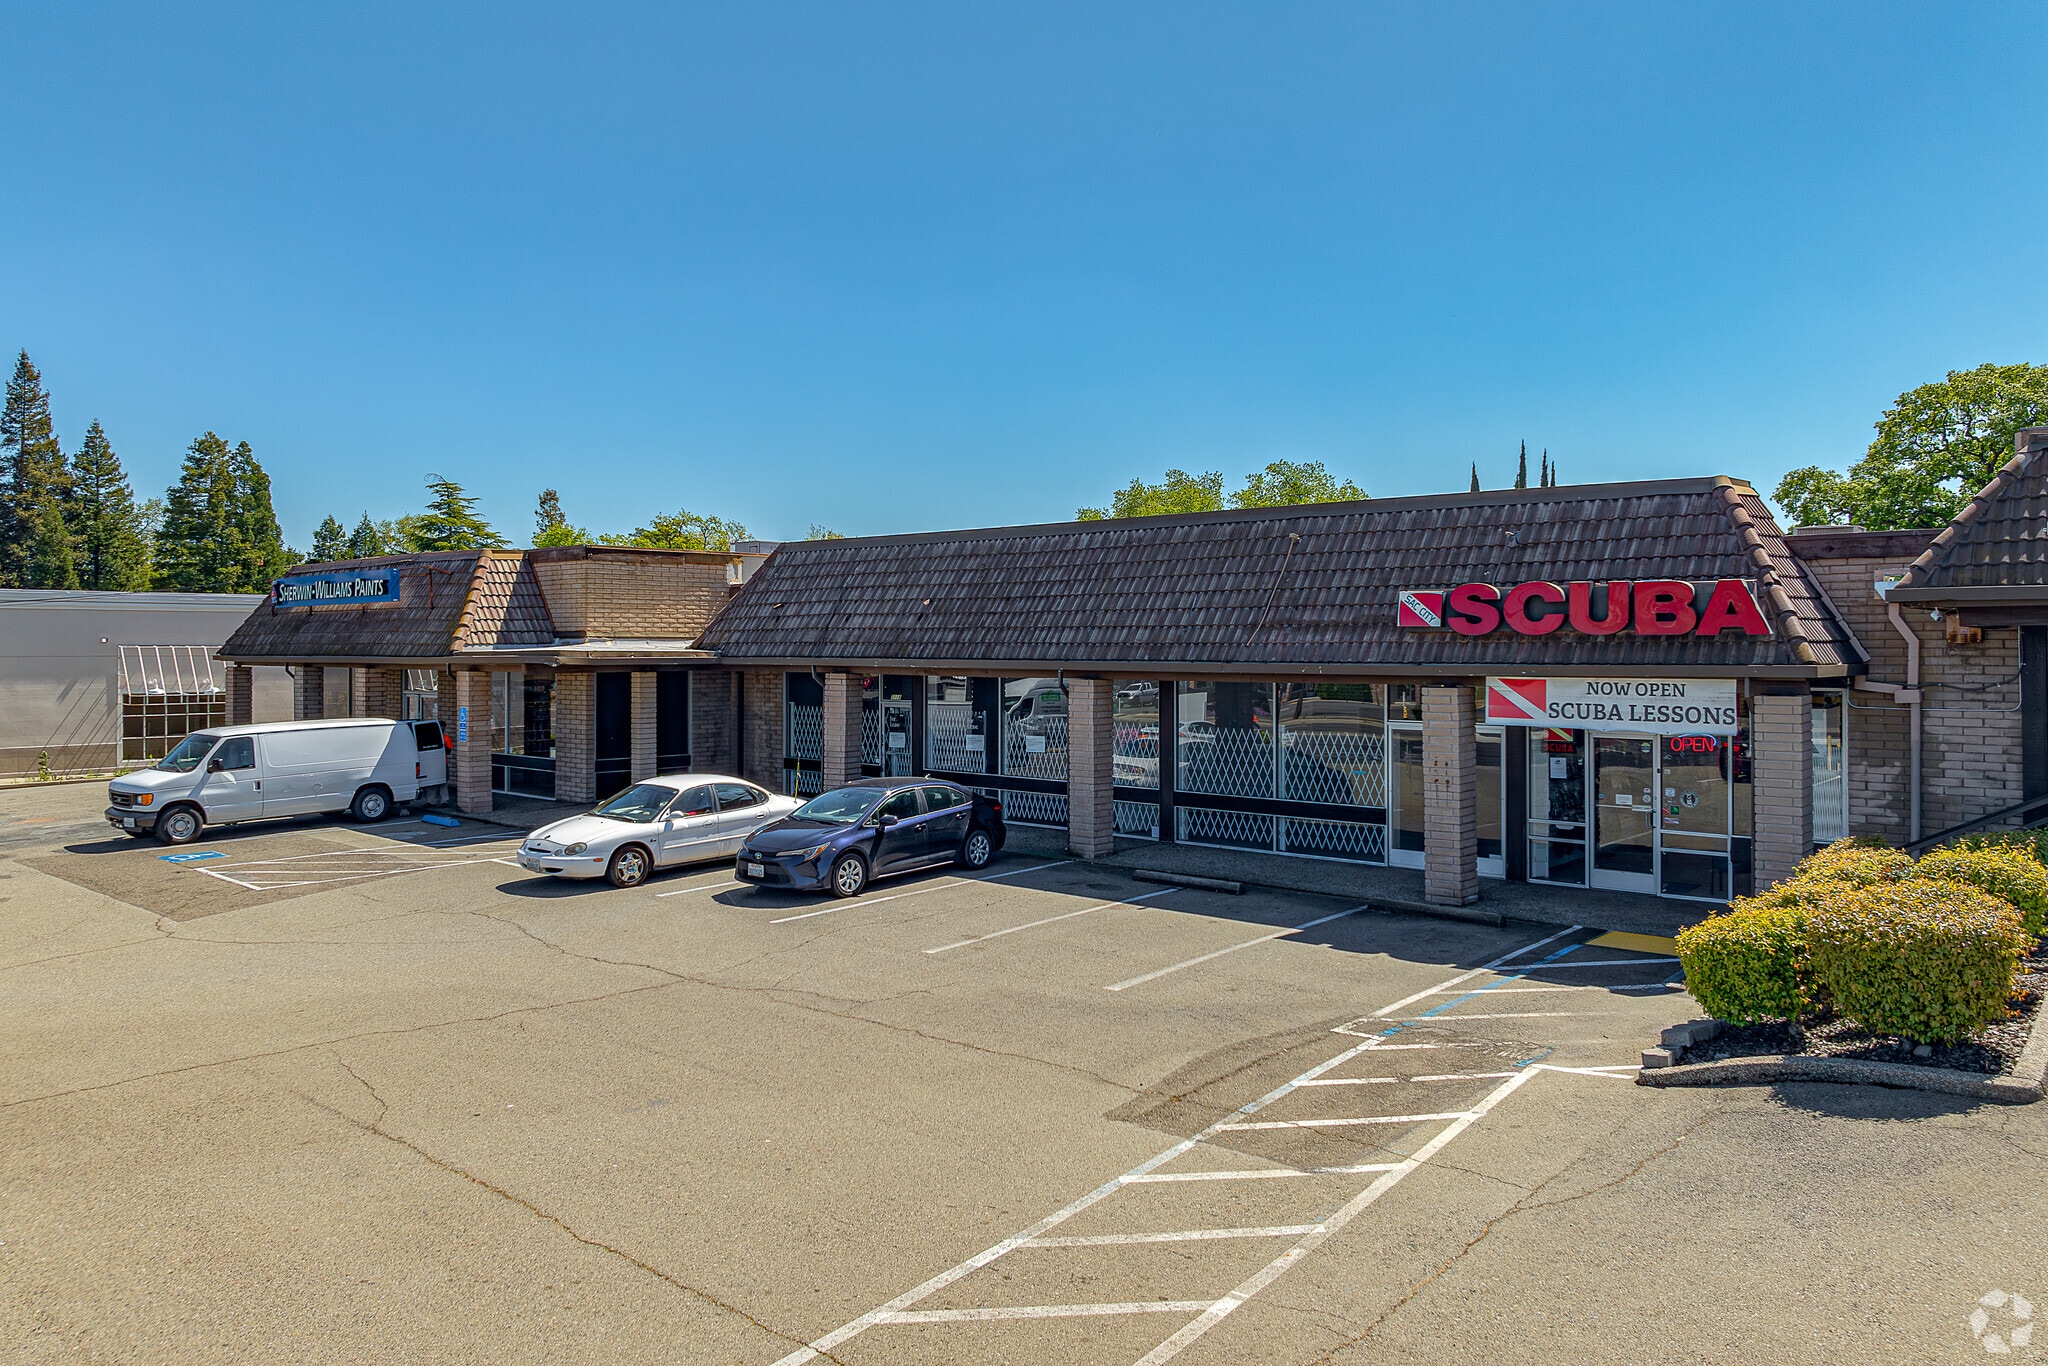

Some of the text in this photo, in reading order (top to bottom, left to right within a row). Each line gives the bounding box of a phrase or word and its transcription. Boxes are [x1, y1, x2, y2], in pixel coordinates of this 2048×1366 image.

[279, 578, 384, 602] SHERWIN-WILLIAMS PAINTS
[1404, 595, 1436, 624] SAC CITY
[1447, 579, 1773, 636] SCUBA
[1586, 681, 1686, 697] NOW OPEN
[1548, 702, 1736, 725] SCUBA LESSONS
[1544, 743, 1574, 752] SCUBA
[1670, 737, 1715, 752] OPEN
